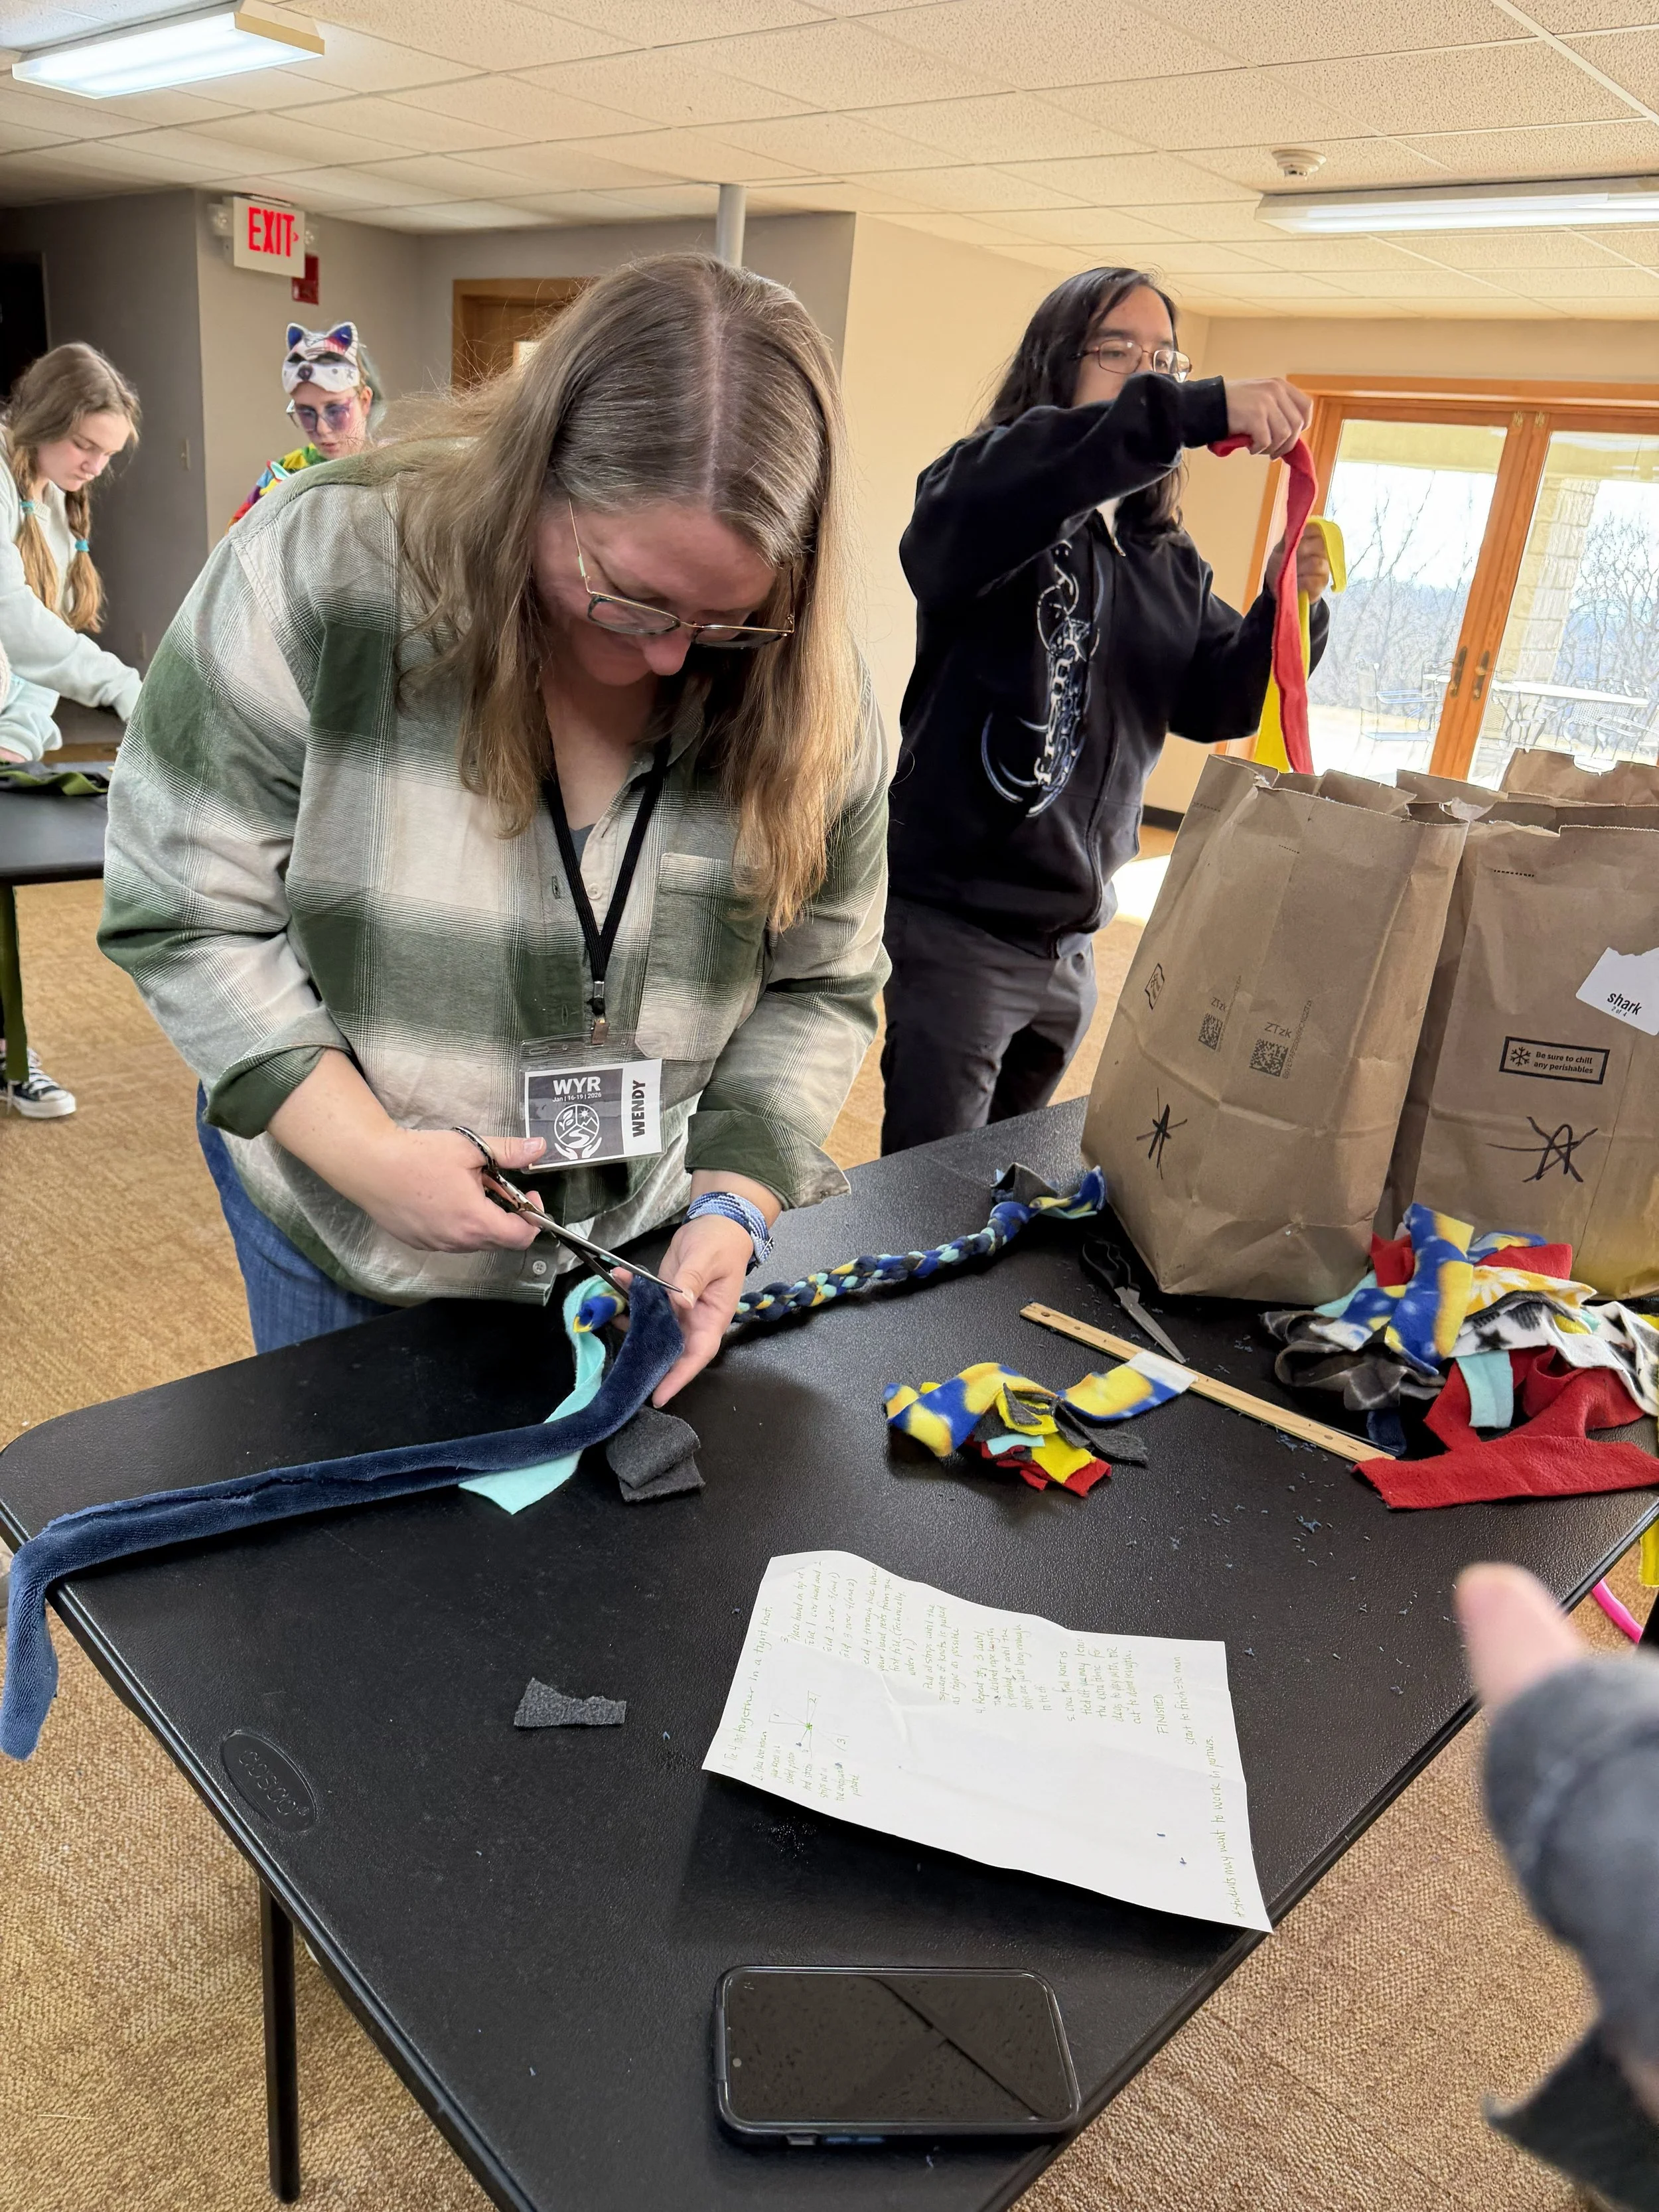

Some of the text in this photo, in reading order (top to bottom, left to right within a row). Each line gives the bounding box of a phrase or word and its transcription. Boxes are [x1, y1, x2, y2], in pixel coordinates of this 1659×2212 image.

[248, 206, 295, 258] EXIT
[1210, 997, 1228, 1012] ZTzk
[1607, 993, 1642, 1015] shark
[1263, 1021, 1293, 1039] ZTzk
[1548, 1064, 1593, 1074] perishables
[553, 1076, 601, 1095] WYR
[631, 1080, 646, 1138] WENDY
[865, 1588, 875, 1604] hole
[877, 1593, 891, 1611] from
[790, 1601, 804, 1621] hand
[862, 1607, 879, 1635] through
[924, 1620, 934, 1639] until
[875, 1632, 887, 1652] hand
[876, 1655, 889, 1672] your
[904, 1655, 916, 1676] under
[1014, 1652, 1032, 1666] long
[922, 1676, 934, 1689] Pull
[938, 1675, 950, 1701] square
[733, 1687, 754, 1733] together
[749, 1671, 758, 1680] in
[950, 1696, 960, 1705] as
[972, 1681, 989, 1704] Repeat
[1080, 1700, 1092, 1715] tied
[1096, 1706, 1107, 1718] the
[1153, 1694, 1169, 1734] FINISHED
[1210, 1782, 1223, 1810] work
[1210, 1829, 1227, 1852] want
[1221, 1856, 1235, 1875] may
